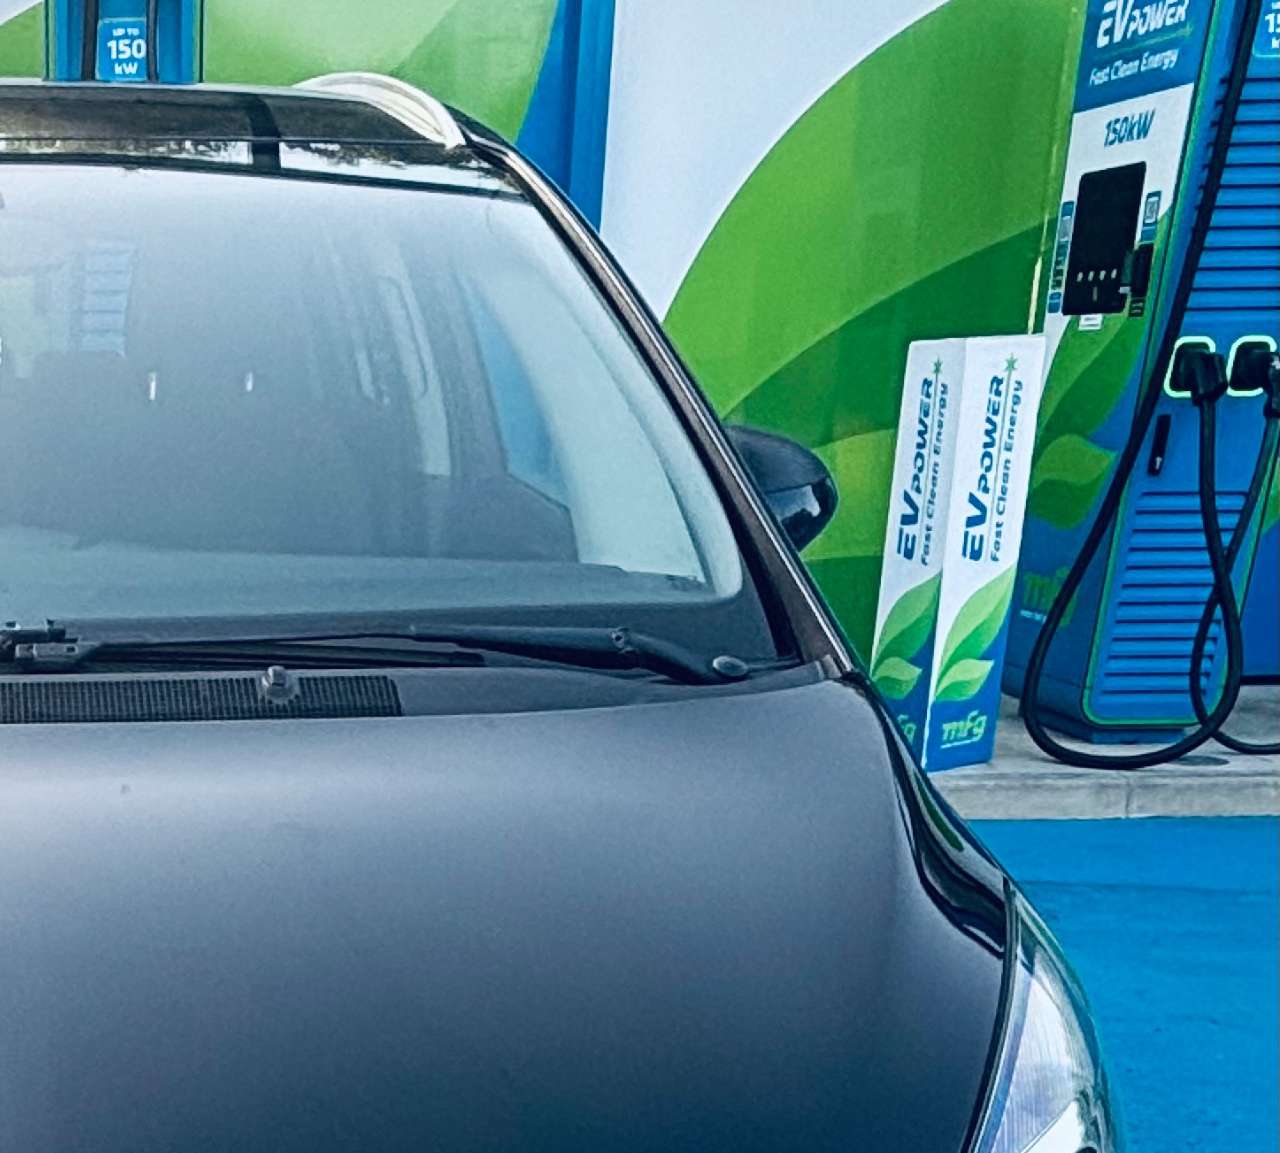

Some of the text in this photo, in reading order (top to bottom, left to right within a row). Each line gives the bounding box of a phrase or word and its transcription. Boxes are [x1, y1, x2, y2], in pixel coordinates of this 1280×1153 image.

[107, 38, 147, 60] 150
[1089, 49, 1179, 86] Fast Clean Energy
[114, 62, 138, 75] kW
[1104, 108, 1156, 148] 150kW
[921, 383, 949, 566] Fast Clean Energy
[990, 379, 1023, 562] Fast Clean Energy
[942, 710, 988, 741] mfg
